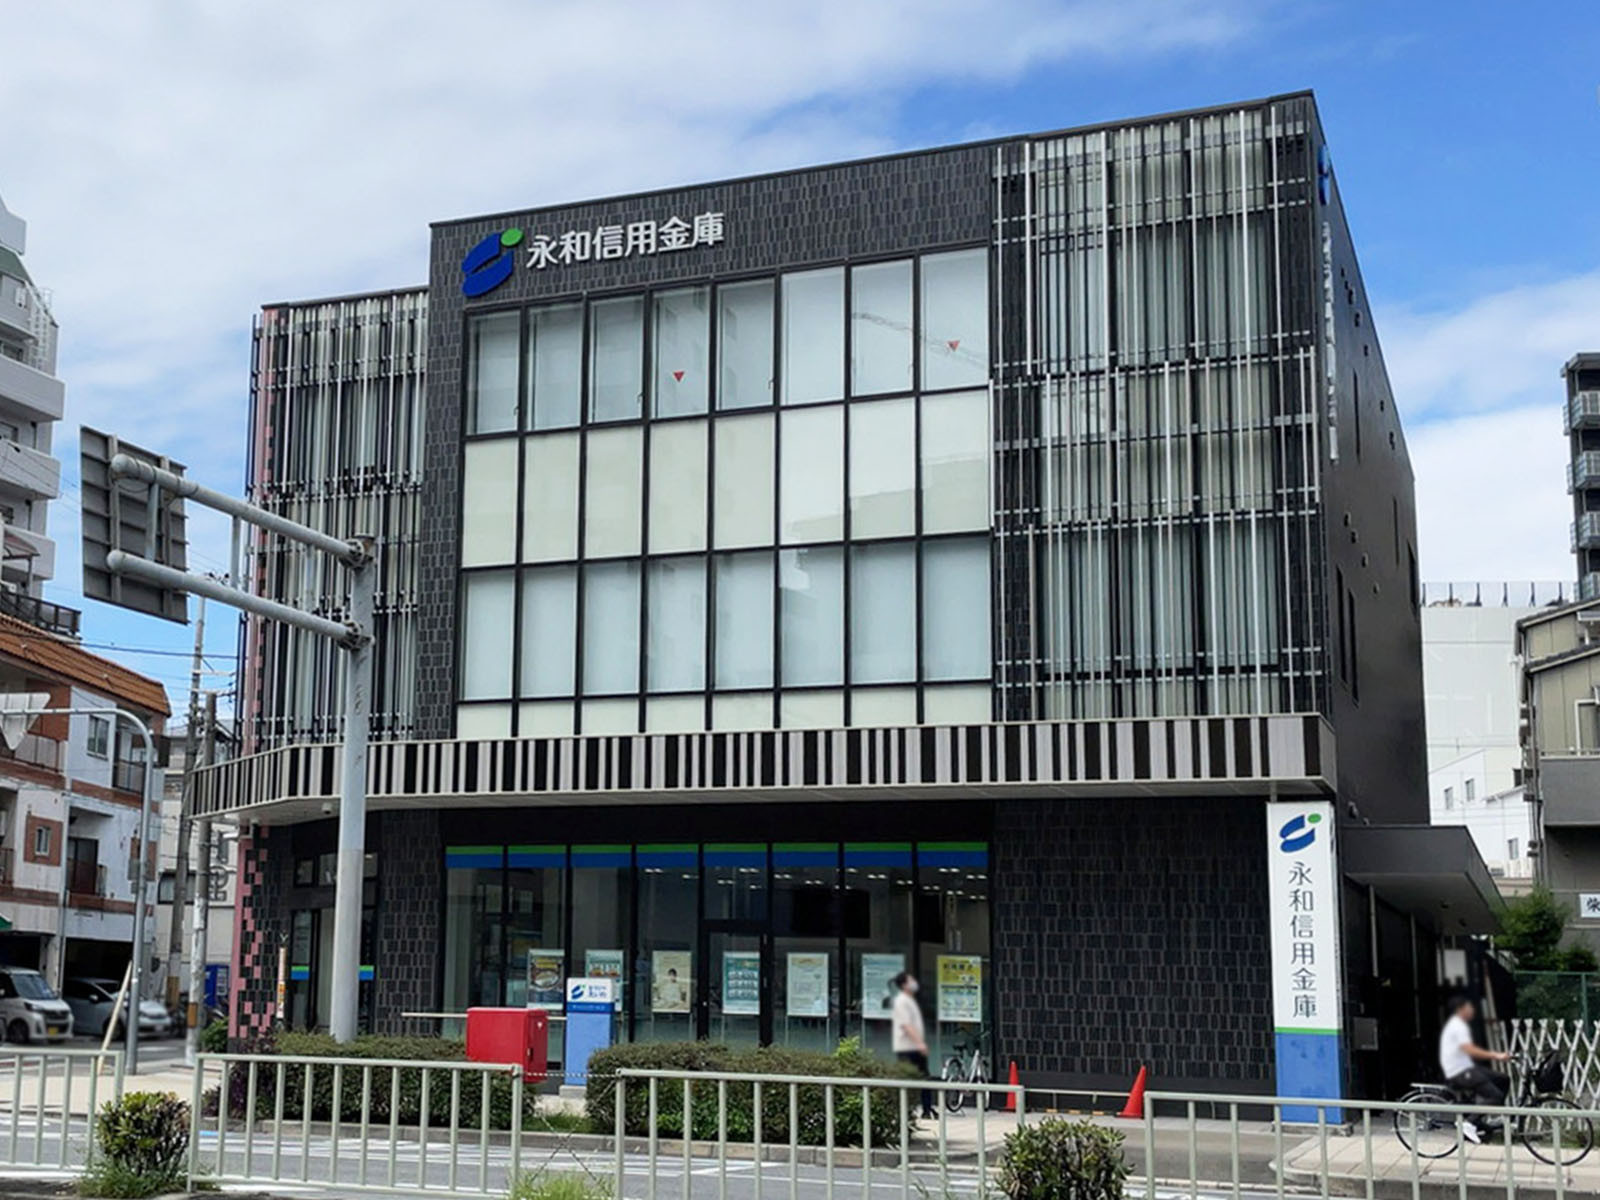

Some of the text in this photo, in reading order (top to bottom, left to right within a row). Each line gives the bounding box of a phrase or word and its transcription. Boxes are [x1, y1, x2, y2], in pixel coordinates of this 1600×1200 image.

[526, 212, 724, 269] 永和信用金庫
[1288, 861, 1317, 1018] 永和信用金庫
